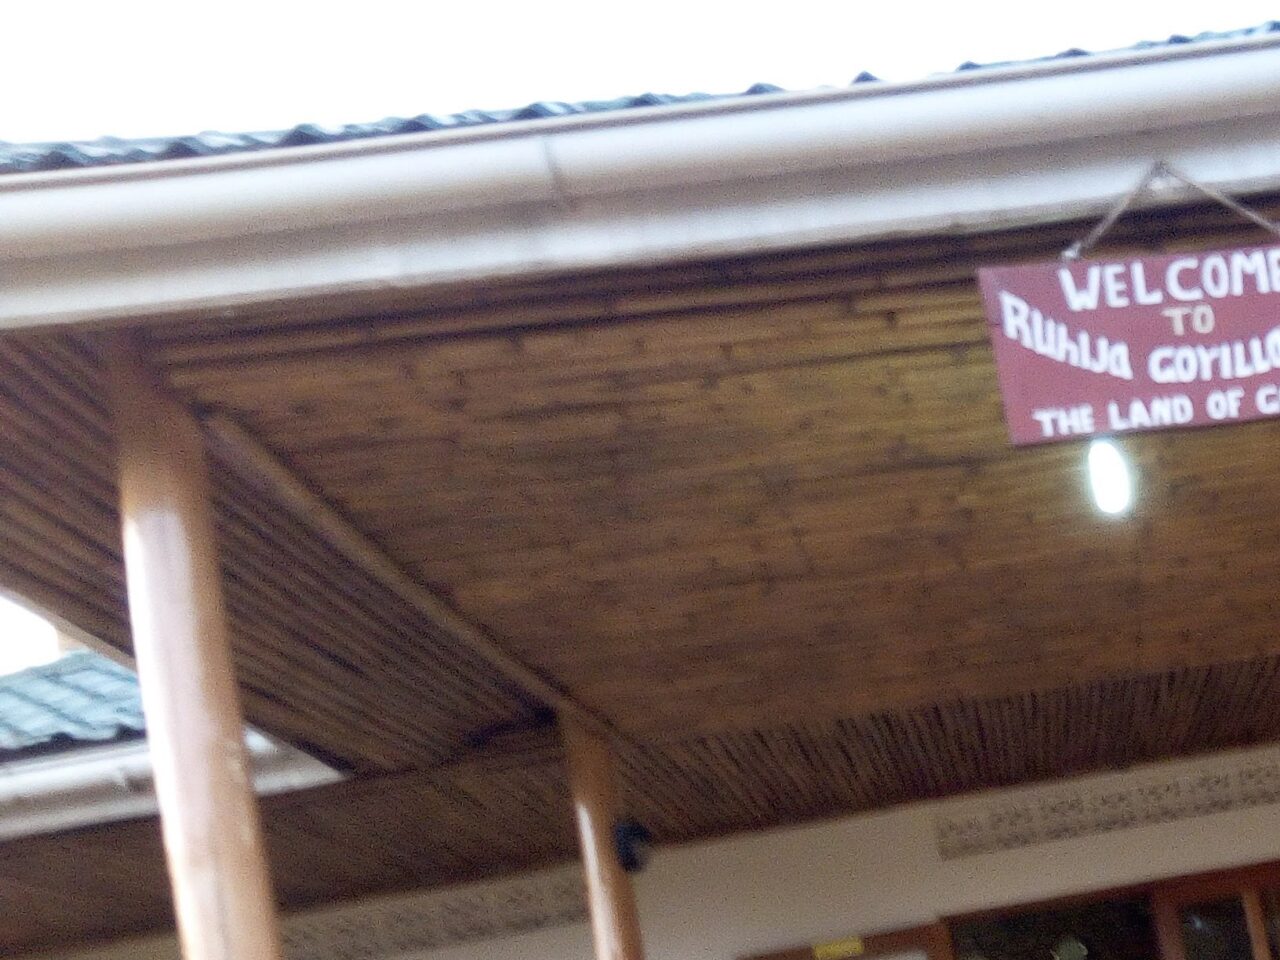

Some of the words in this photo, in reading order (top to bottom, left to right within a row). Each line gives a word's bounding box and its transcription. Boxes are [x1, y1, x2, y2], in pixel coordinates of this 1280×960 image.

[1161, 304, 1215, 336] TO
[1032, 403, 1097, 438] THE
[1107, 394, 1194, 431] LAND
[1205, 387, 1245, 420] OF
